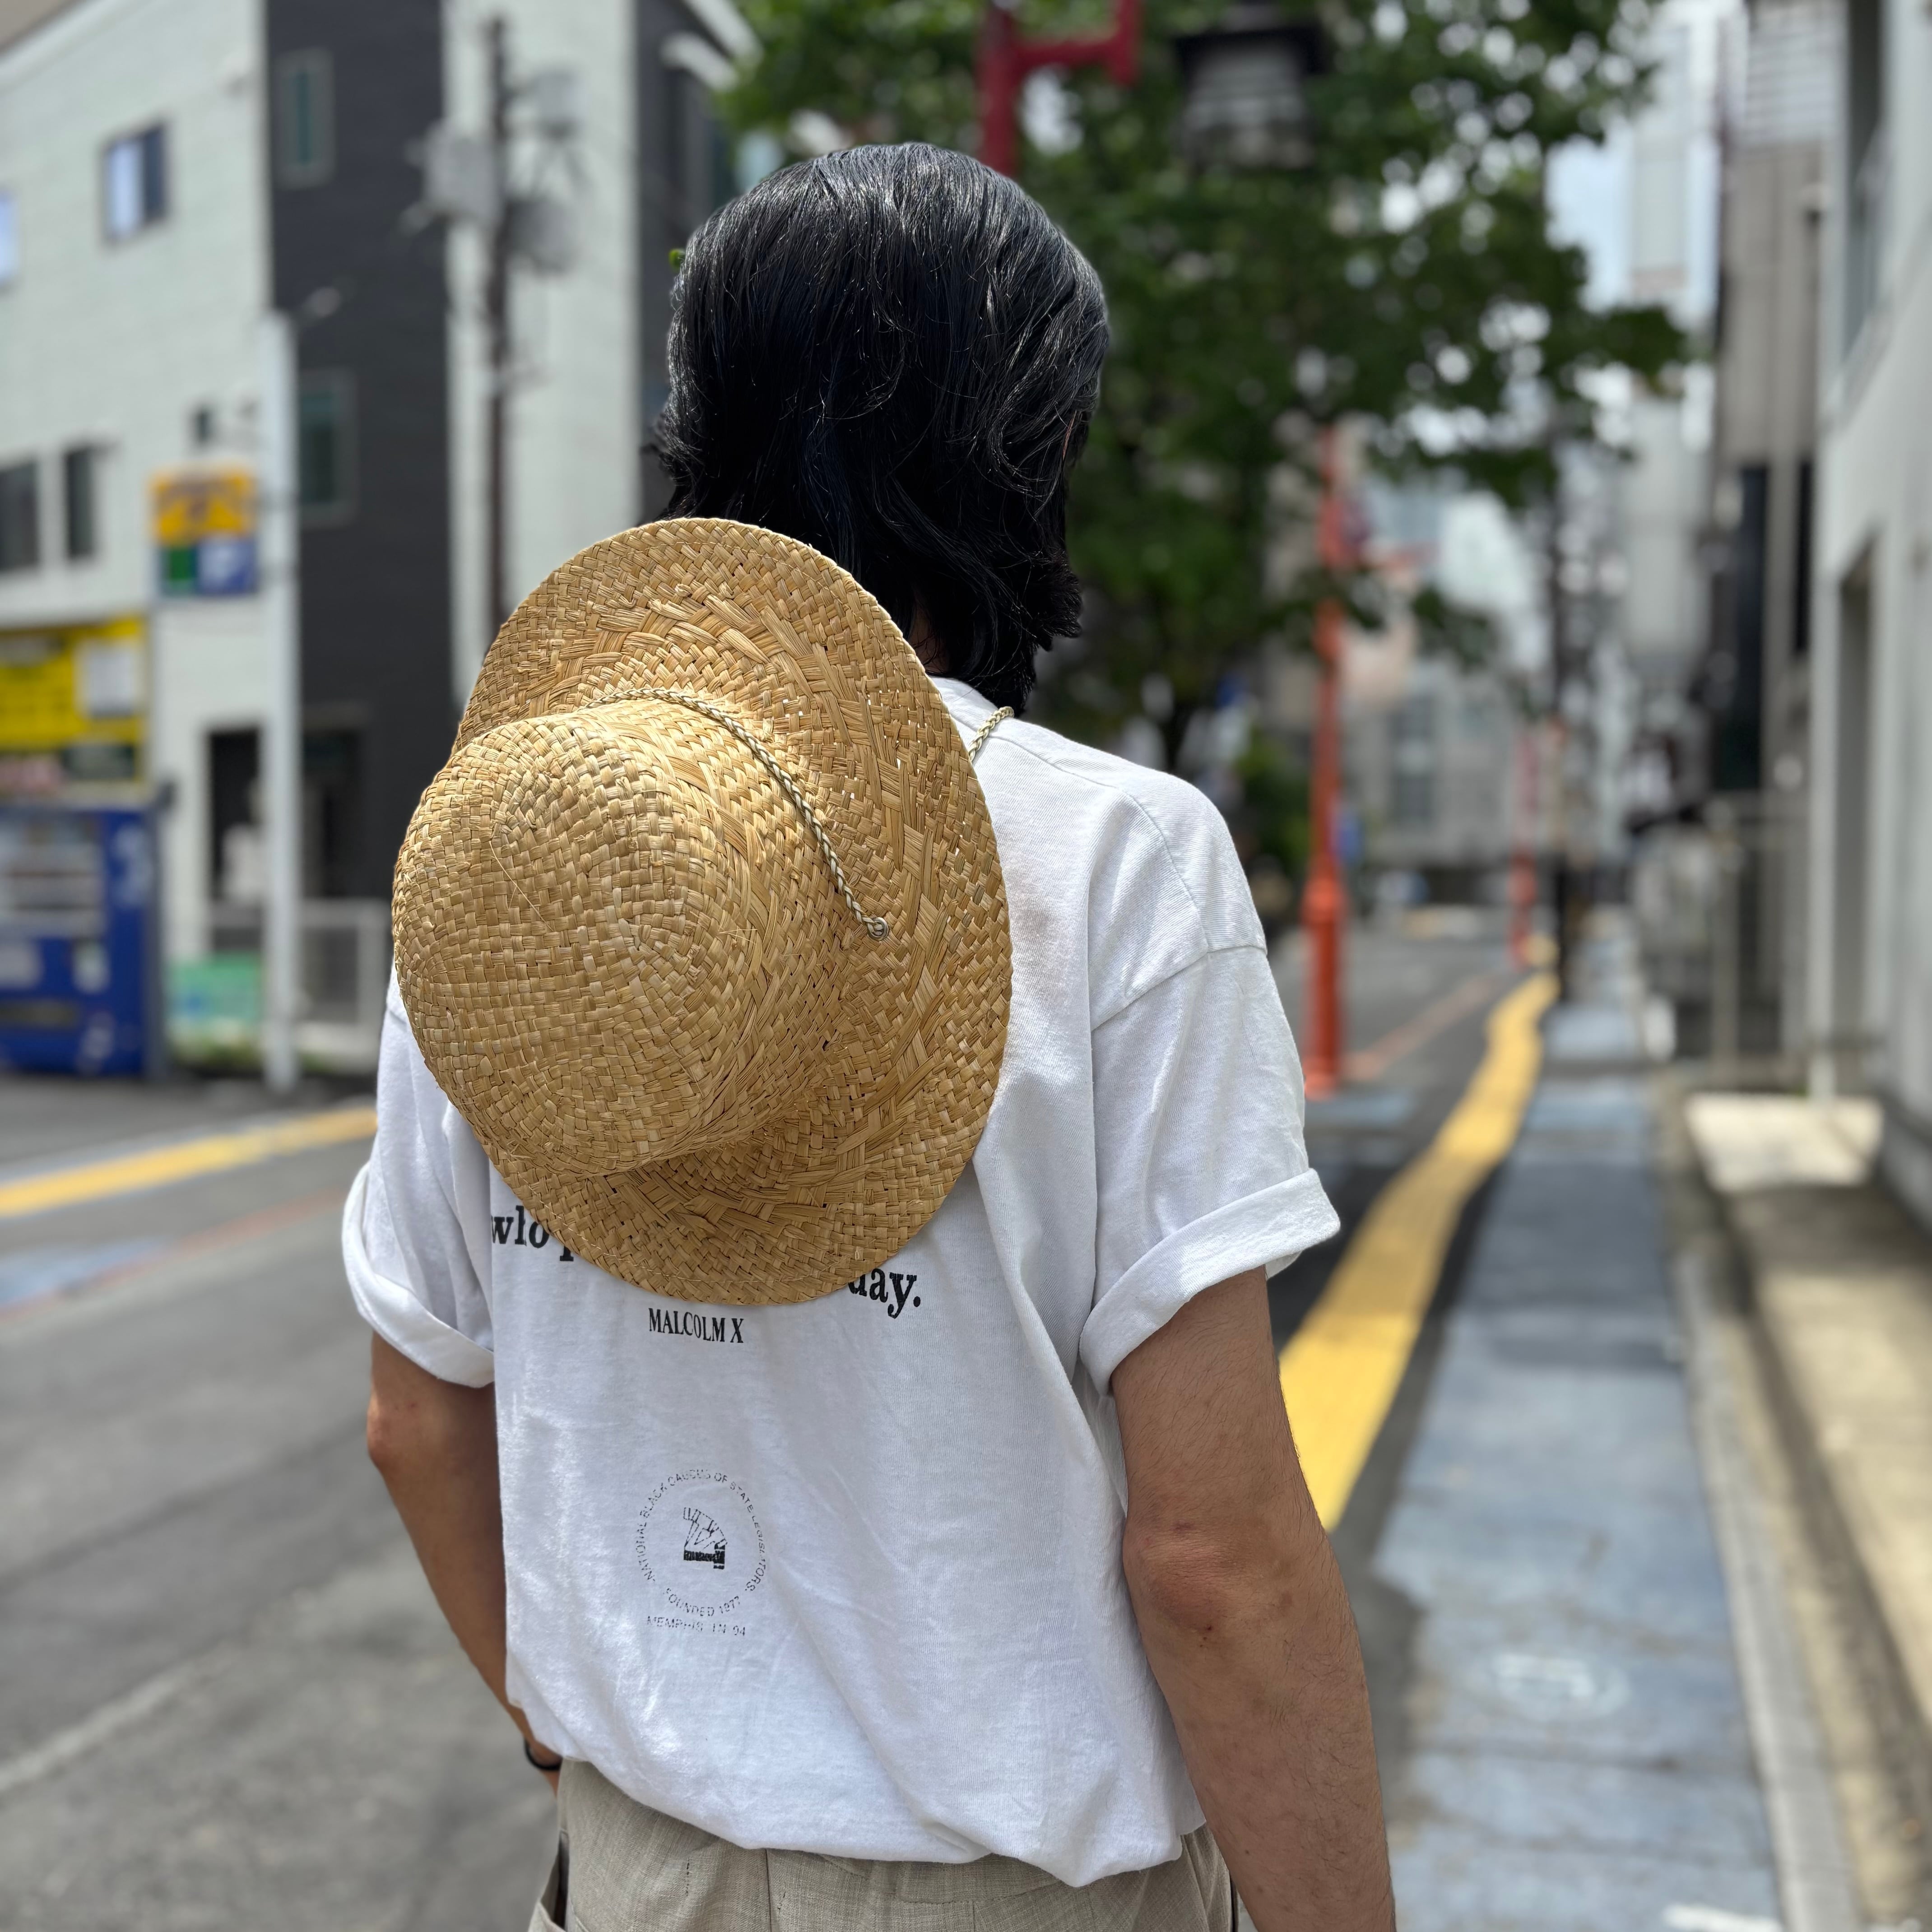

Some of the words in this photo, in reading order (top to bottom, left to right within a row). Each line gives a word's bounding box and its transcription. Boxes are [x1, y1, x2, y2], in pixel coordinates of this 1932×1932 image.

[648, 1308, 726, 1342] MALCOLM
[730, 1318, 744, 1343] X
[714, 1472, 728, 1483] OF
[730, 1481, 753, 1513] STATE
[663, 1588, 715, 1616] FOUNDED
